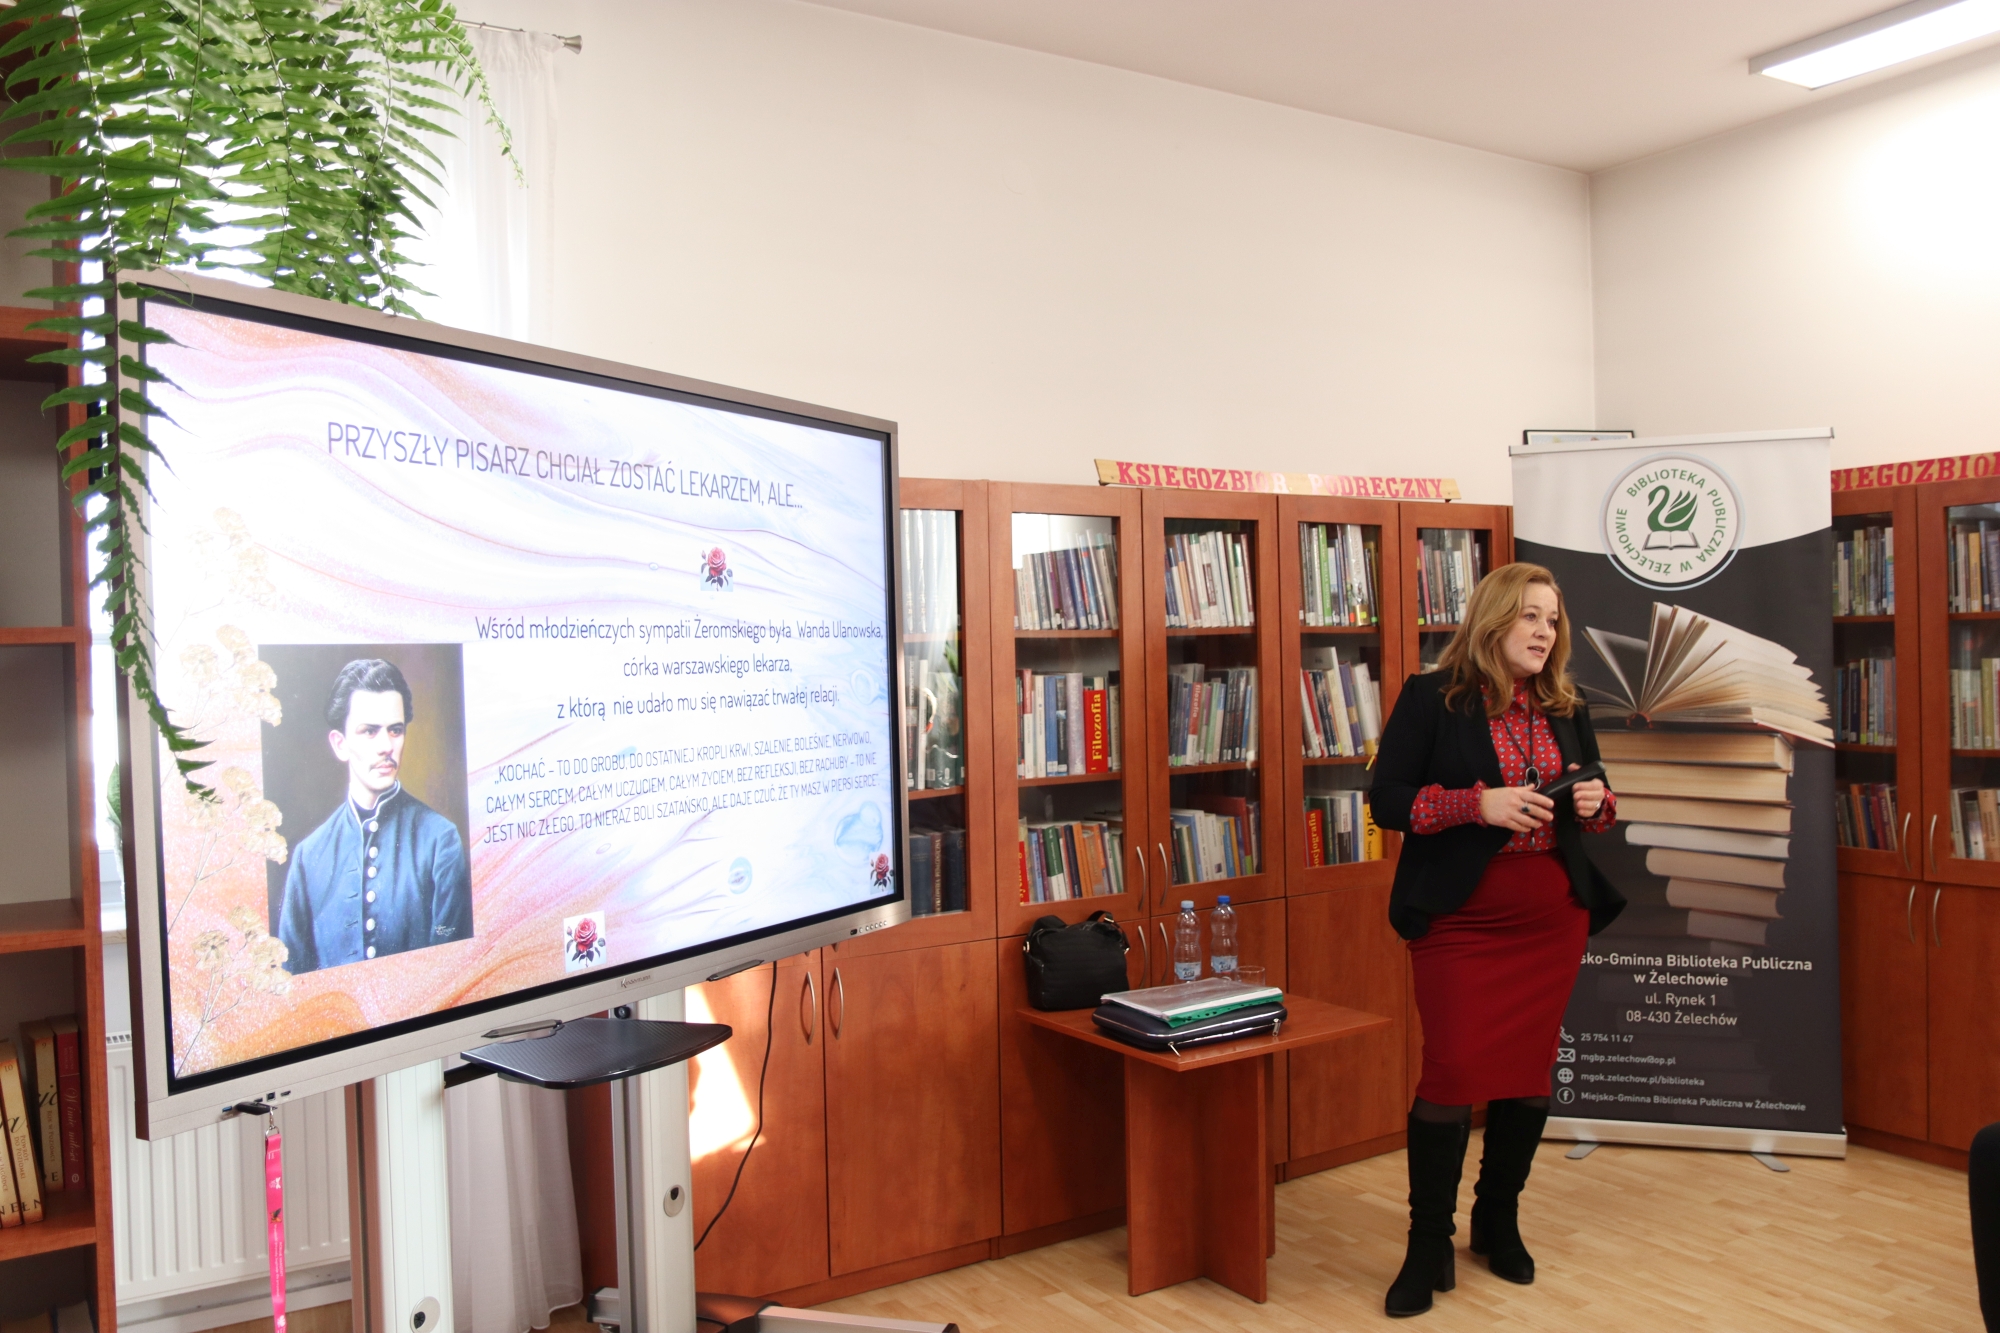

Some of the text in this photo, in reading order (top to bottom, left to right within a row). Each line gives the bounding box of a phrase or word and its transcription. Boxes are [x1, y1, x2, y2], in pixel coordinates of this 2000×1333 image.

[327, 421, 804, 509] PRZYSZŁY PISARZ CHCIAŁ ZOSTAĆ LEKARZEM, ALE...
[1615, 468, 1727, 576] BIBLIOTEKA PUBLICZNA W ŻELECHOWIE
[475, 614, 884, 645] Wśród młodzieńczych sympatii Żeromskiego była Wanda Ulanowska,
[623, 653, 793, 679] córka warszawskiego lekarza,
[557, 684, 840, 721] z którą nie udało mu się nawiązać trwałej relacji.
[1193, 684, 1202, 717] filozofia
[1091, 694, 1102, 760] Filozofia
[494, 757, 546, 785] „KOCHAĆ
[557, 759, 571, 776] TO
[574, 757, 588, 775] DO
[591, 754, 628, 773] GROBU,
[629, 752, 643, 769] DO
[645, 747, 695, 768] OSTATNIEJ
[697, 745, 728, 761] KROPLI
[729, 742, 753, 758] KRWI,
[754, 738, 794, 756] SZALENIE,
[794, 733, 832, 752] BOLEŚNIE,
[832, 731, 872, 748] NERWOWO,
[486, 792, 526, 814] CAŁYM
[528, 787, 576, 809] SERCEM,
[578, 782, 613, 802] CAŁYM
[615, 776, 667, 798] UCZUCIEM,
[669, 772, 700, 791] CAŁYM
[701, 769, 736, 787] ŻYCIEM,
[737, 766, 753, 782] BEZ
[755, 761, 798, 780] REFLEKSJI,
[799, 759, 814, 775] BEZ
[815, 755, 849, 773] RACHUBY
[855, 753, 864, 767] TO
[865, 751, 877, 766] NIE
[483, 822, 513, 844] JEST
[517, 820, 537, 839] NIC
[579, 812, 592, 830] TO
[594, 807, 632, 828] NIERAZ
[633, 804, 655, 822] BOLI
[656, 795, 711, 819] SZATAŃSKO,
[712, 793, 728, 811] ALE
[730, 790, 753, 808] DAJE
[754, 784, 778, 804] CZUĆ,
[778, 783, 788, 801] ŻE
[789, 784, 799, 799] TY
[801, 781, 822, 797] MASZ
[822, 779, 830, 794] W
[831, 776, 854, 792] PIERSI
[1667, 954, 1738, 968] Biblioteka
[1742, 956, 1813, 971] Publiczna
[1634, 968, 1729, 986] w Żelechowie
[1645, 993, 1717, 1008] ul. Rynek 1
[1626, 1009, 1738, 1026] 08-430 Żelechów
[1580, 1033, 1634, 1043] 25 754 11 47
[1580, 1053, 1676, 1066] mgbp.zelechow@op.pl
[1580, 1072, 1705, 1086] mgok.zelechow.pl/biblioteka
[1581, 1091, 1651, 1104] Miejsko-Gminna
[1653, 1095, 1697, 1106] Biblioteka
[1700, 1097, 1743, 1108] Publiczna
[1745, 1100, 1753, 1108] w
[1755, 1098, 1807, 1111] Żelechowie
